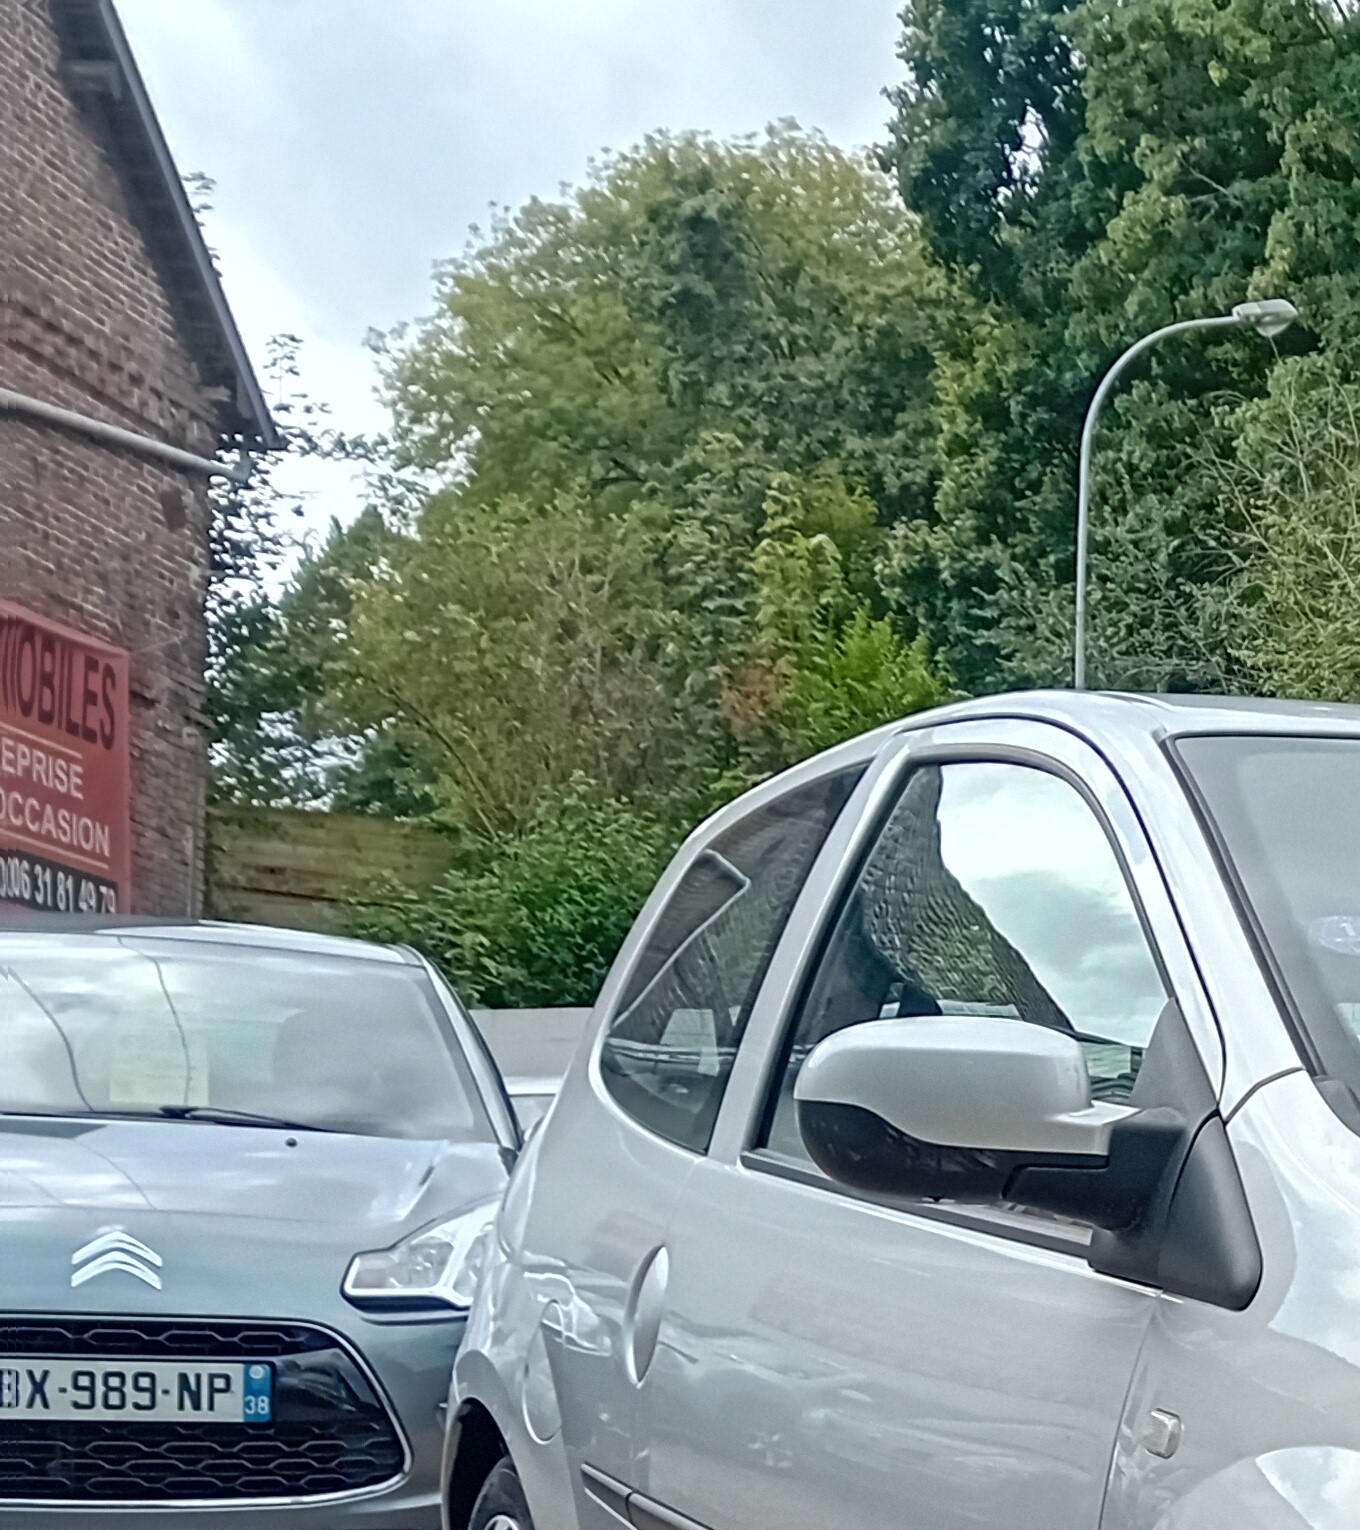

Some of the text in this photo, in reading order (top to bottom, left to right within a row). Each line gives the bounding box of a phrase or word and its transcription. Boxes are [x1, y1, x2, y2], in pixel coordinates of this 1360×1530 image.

[0, 616, 117, 750] OBILES
[34, 864, 53, 907] 31
[56, 871, 74, 913] 81
[244, 1394, 270, 1416] 38
